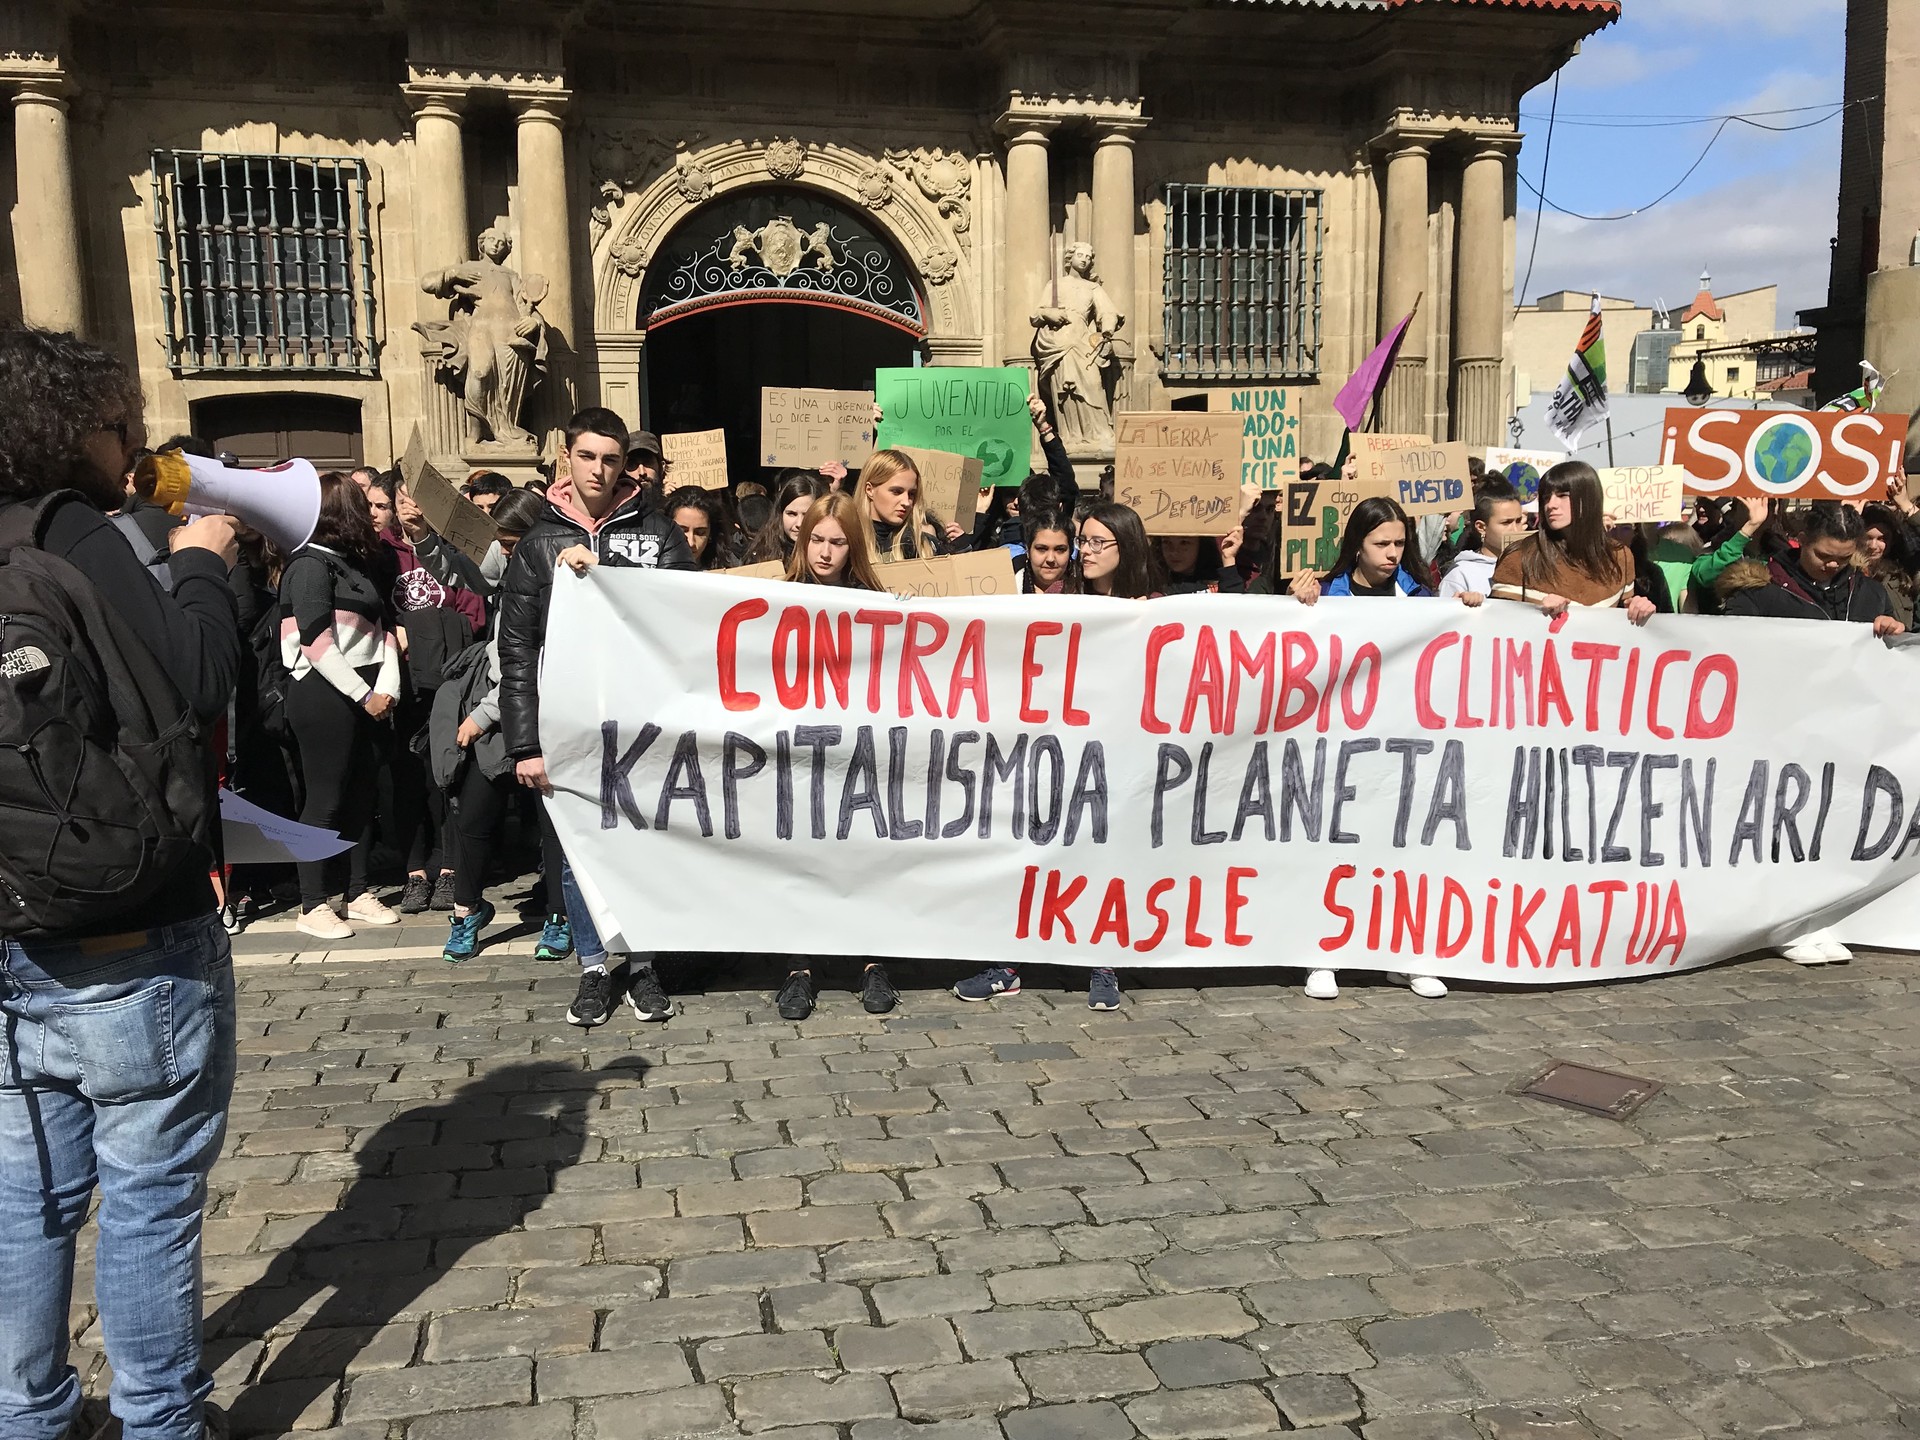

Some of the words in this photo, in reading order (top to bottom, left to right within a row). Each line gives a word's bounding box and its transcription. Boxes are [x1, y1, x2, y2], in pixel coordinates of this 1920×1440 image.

[615, 283, 628, 318] PATET
[640, 195, 681, 240] OMNIBUS
[719, 161, 756, 178] JANVA
[819, 164, 842, 179] COR
[893, 209, 922, 241] VALDE
[939, 289, 953, 328] MAGIS
[769, 391, 788, 407] ES
[793, 397, 819, 410] UNA
[828, 400, 874, 412] URGENCIA
[893, 379, 1026, 420] JUVENTUD
[1231, 391, 1251, 411] NI
[1254, 388, 1287, 412] UN
[769, 413, 783, 424] LO
[790, 412, 811, 423] DICE
[817, 414, 831, 424] LA
[837, 415, 873, 425] CIENCIA
[664, 437, 678, 449] NO
[680, 435, 701, 448] HACE
[934, 425, 953, 438] POR
[961, 425, 974, 437] EL
[1118, 419, 1146, 444] LA
[697, 447, 712, 457] NOS
[1252, 433, 1296, 460] UNA
[920, 460, 937, 479] UN
[1148, 461, 1167, 476] SE
[1400, 448, 1447, 474] MALDITO
[1614, 467, 1664, 485] STOP
[1605, 481, 1674, 502] CLIMATE
[1287, 482, 1320, 526] EZ
[1322, 505, 1340, 540] B
[609, 533, 637, 541] ROUGH
[608, 540, 660, 564] 512
[908, 581, 949, 597] YOU
[964, 575, 998, 596] TO
[1, 648, 27, 661] THE
[0, 656, 30, 677] ORTH
[5, 662, 34, 679] FACE
[717, 598, 990, 723] CONTRA
[1020, 620, 1091, 727] EL
[1141, 622, 1382, 736] CAMBIO
[1415, 613, 1739, 740] CLIMÁTICO
[601, 721, 1109, 847] KAPITALISMOA
[1150, 738, 1469, 849] PLANETA
[1502, 745, 1717, 867] HILTZEN
[1728, 760, 1835, 867] ARI
[1015, 865, 1258, 953] IKASLE
